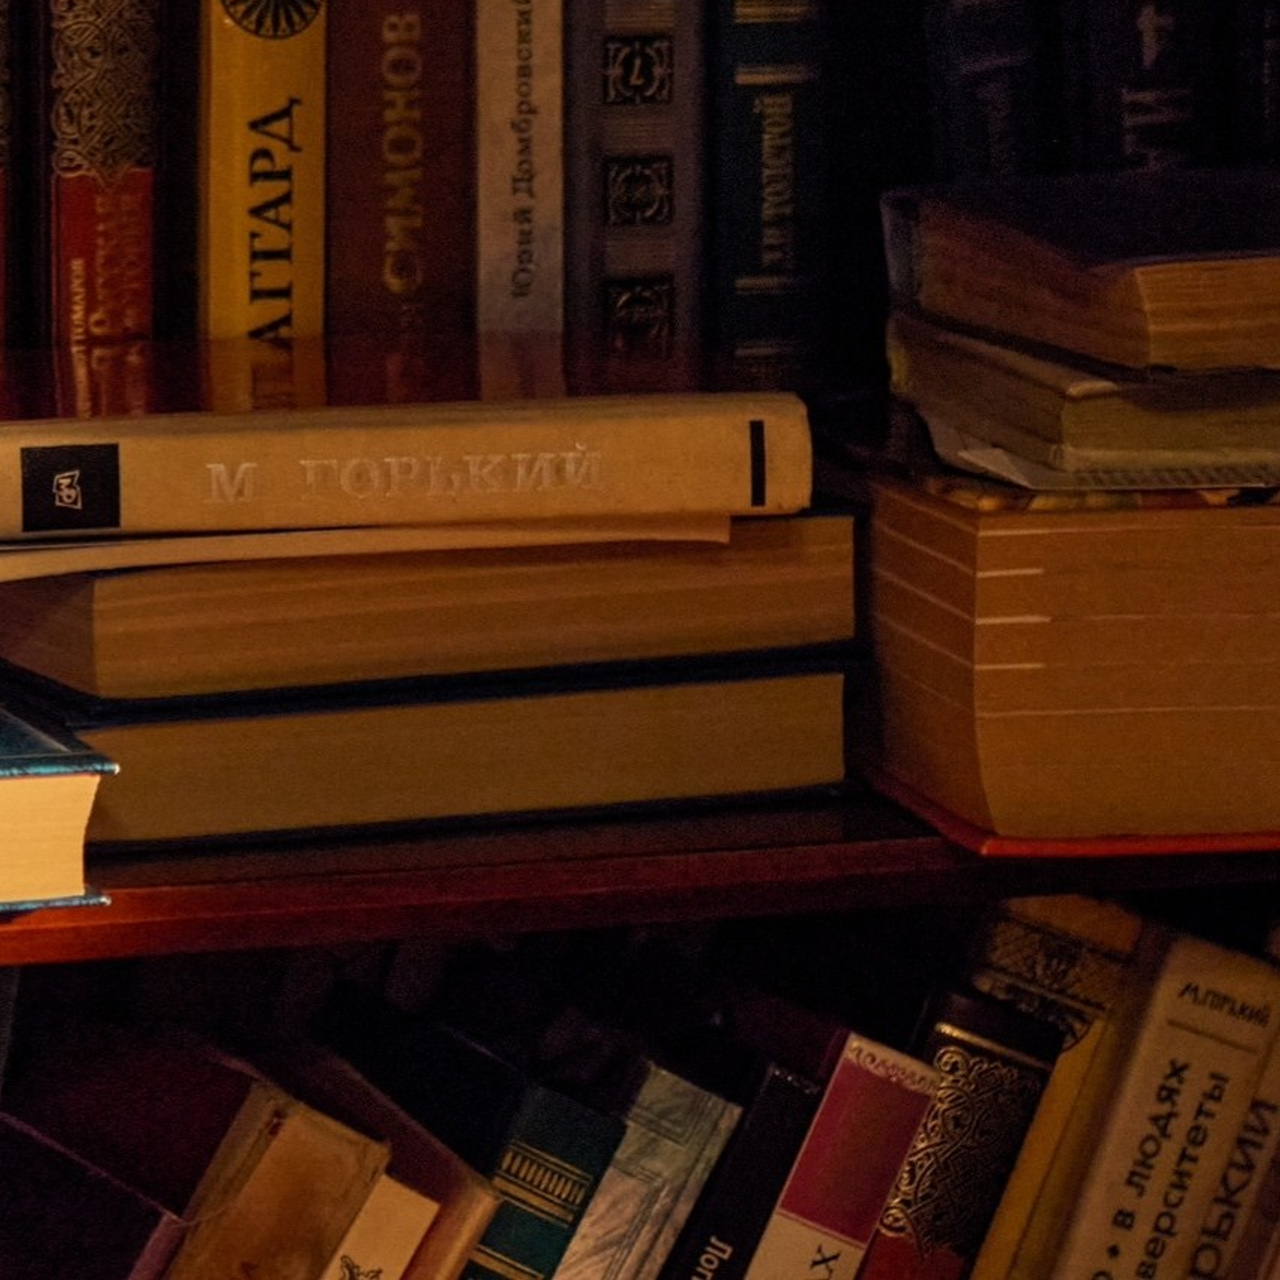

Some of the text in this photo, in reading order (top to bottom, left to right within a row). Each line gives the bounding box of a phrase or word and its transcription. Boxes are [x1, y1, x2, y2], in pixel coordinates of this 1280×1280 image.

[248, 97, 302, 352] АГГАРД
[381, 13, 423, 296] СИМОНОВ
[205, 441, 604, 505] М ГОРЬКИЙ
